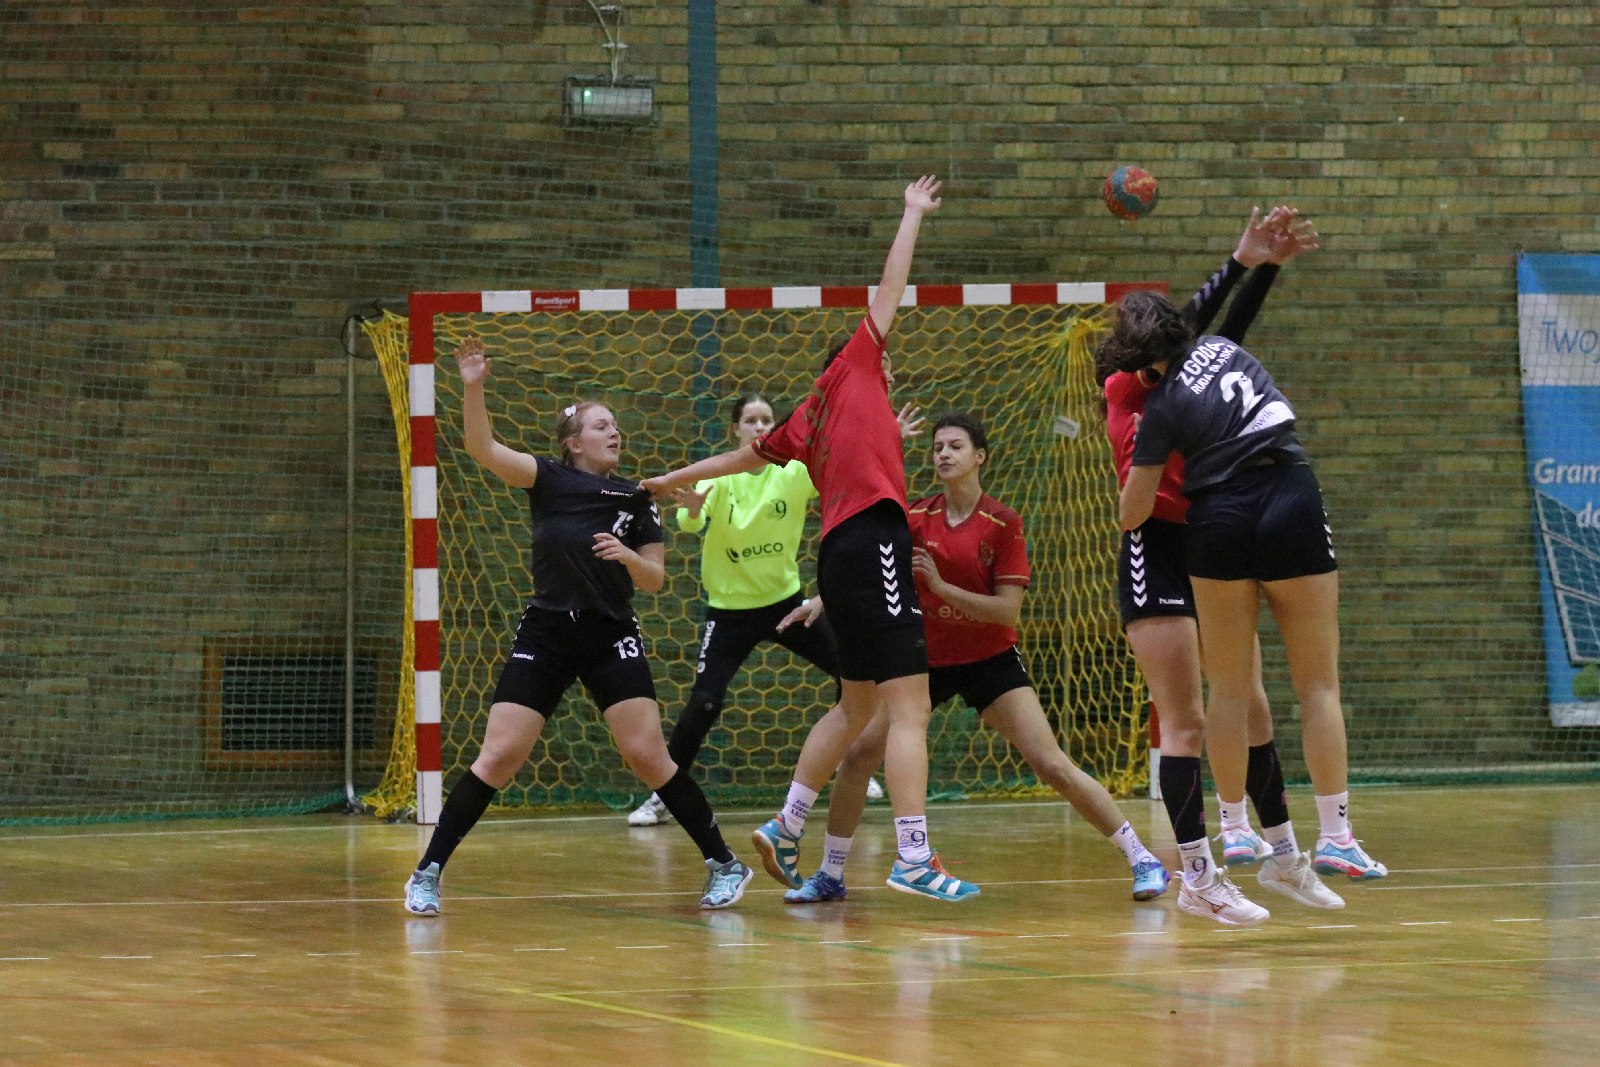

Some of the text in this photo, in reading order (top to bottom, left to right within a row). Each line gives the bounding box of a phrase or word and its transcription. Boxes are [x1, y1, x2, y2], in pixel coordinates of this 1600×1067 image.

[1542, 320, 1600, 364] Two
[1175, 342, 1226, 387] ZGODA
[1190, 373, 1216, 395] RUDA
[1220, 371, 1265, 419] 2
[742, 542, 784, 558] euco
[612, 636, 640, 660] 13
